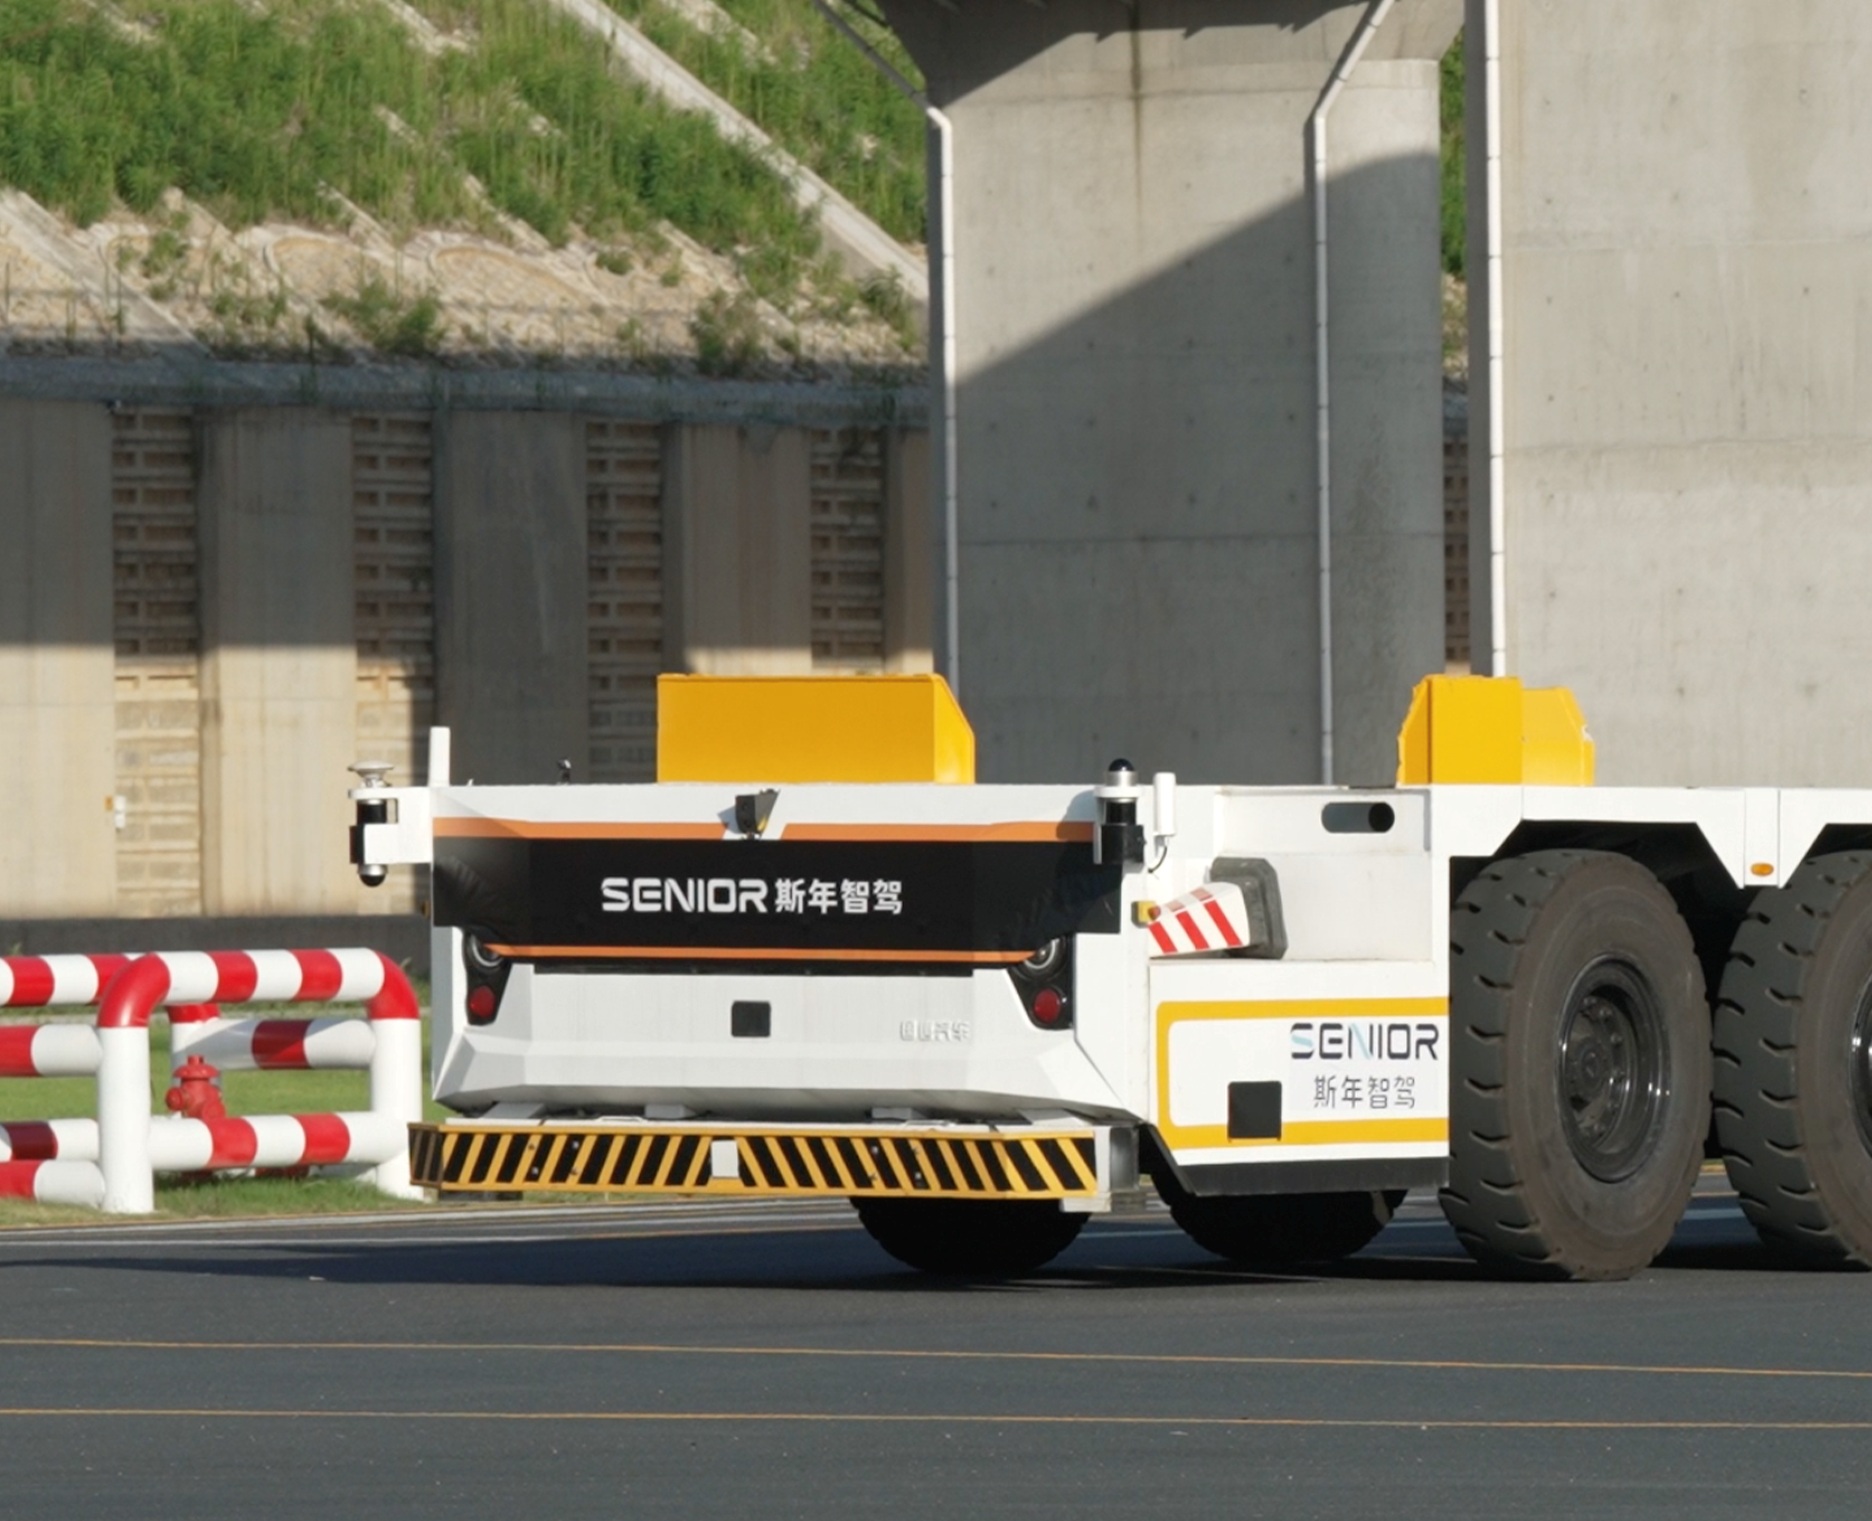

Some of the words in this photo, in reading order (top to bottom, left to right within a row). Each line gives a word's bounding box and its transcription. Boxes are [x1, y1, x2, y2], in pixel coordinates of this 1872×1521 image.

[601, 877, 768, 913] SENIOR
[774, 878, 903, 915] 斯年智驾
[1290, 1022, 1440, 1061] SENIOR
[1313, 1075, 1416, 1110] 斯年智驾
